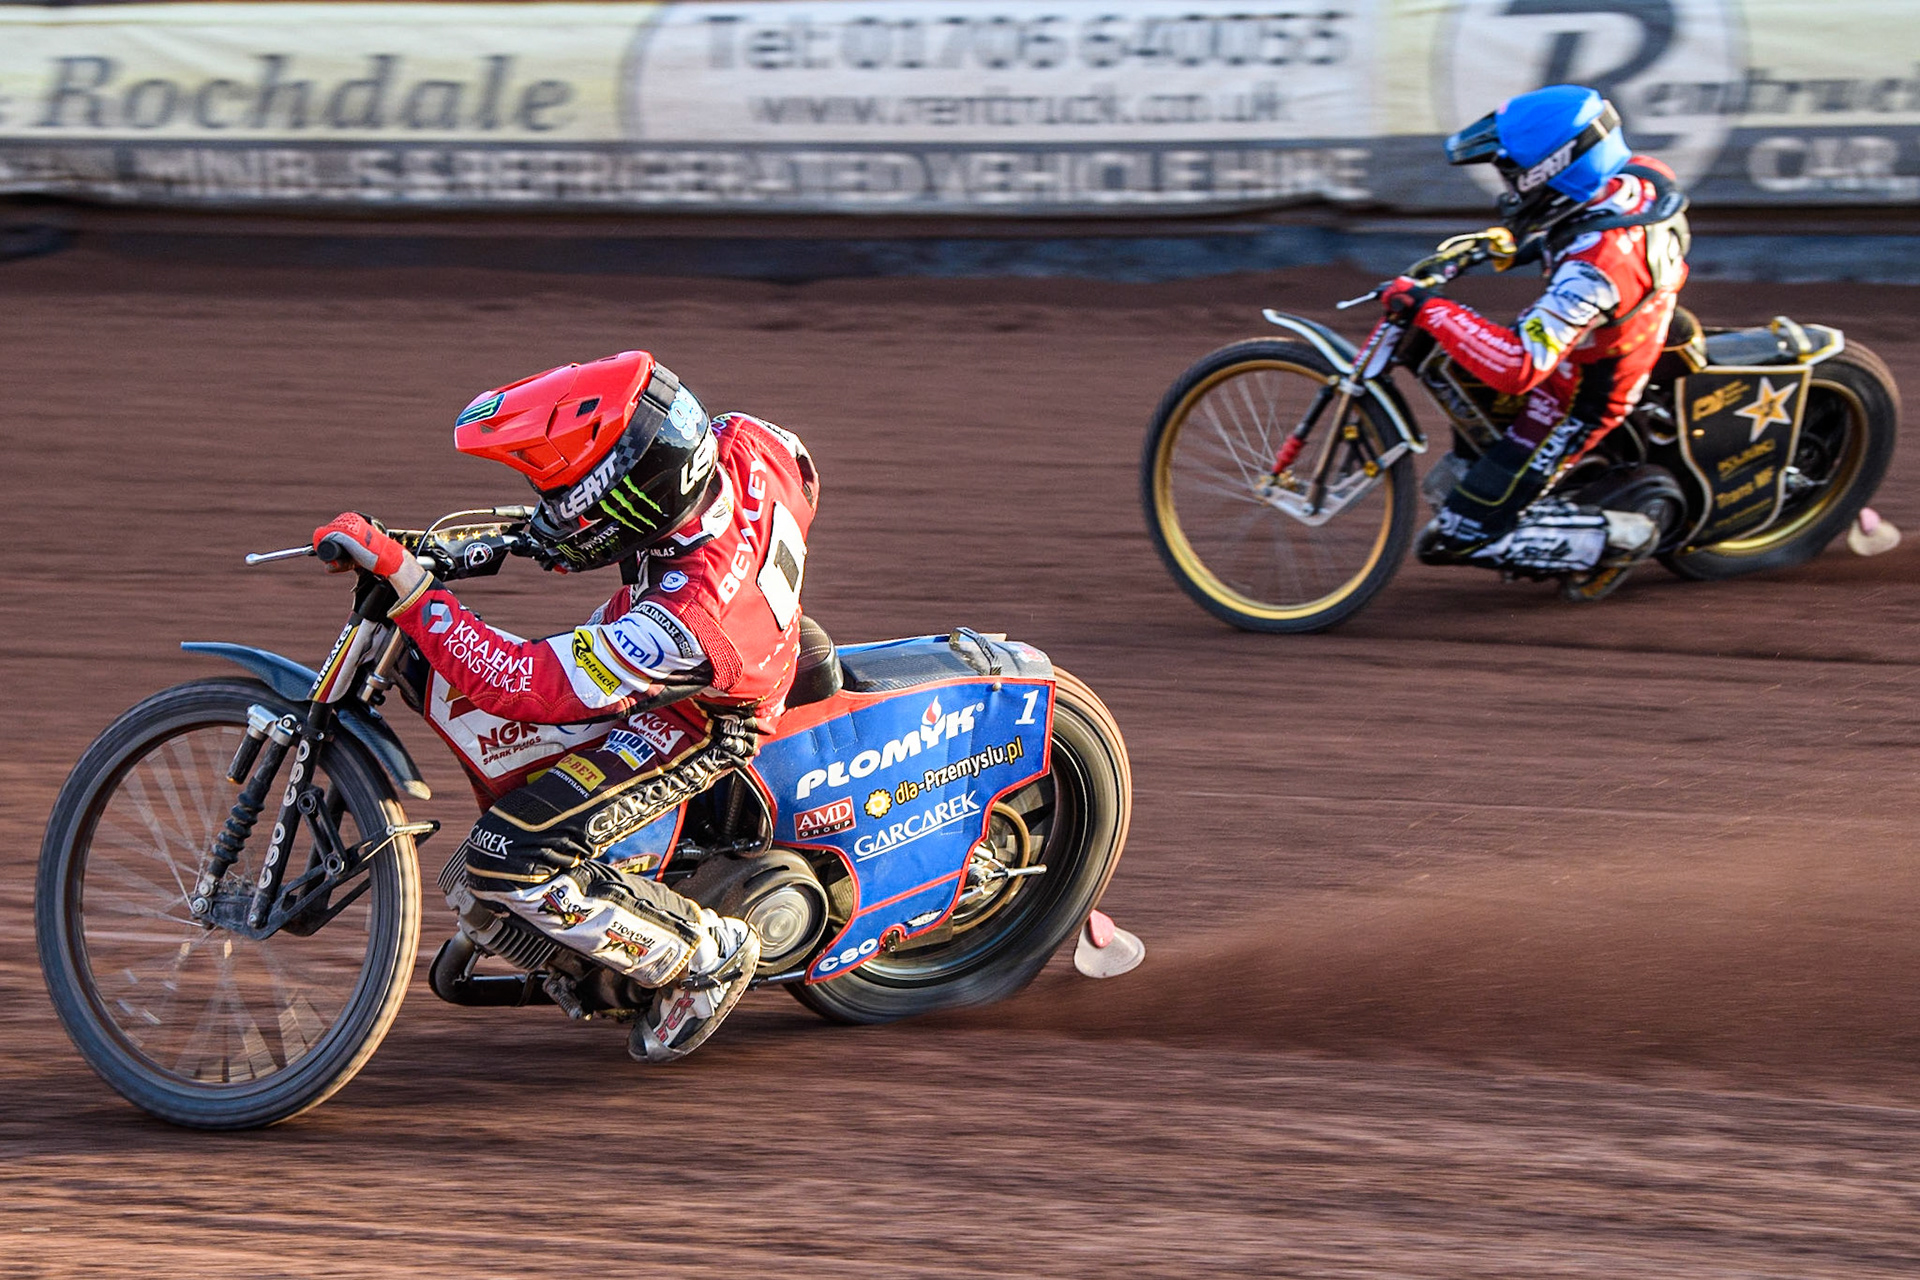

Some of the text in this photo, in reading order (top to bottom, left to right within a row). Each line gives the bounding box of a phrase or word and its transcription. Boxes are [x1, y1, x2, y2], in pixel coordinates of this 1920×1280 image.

[841, 15, 1068, 70] 01706
[32, 53, 578, 132] Rochdale
[559, 450, 618, 519] LEATT
[574, 631, 615, 690] Rentruck
[1014, 688, 1040, 726] 1
[477, 720, 539, 756] NGK
[632, 711, 678, 742] NGK
[645, 731, 667, 749] PLUGS
[483, 735, 542, 766] SPARK PLUGS
[796, 698, 977, 800] PŁOMYK
[797, 799, 852, 831] AMD
[801, 819, 851, 838] GROUP
[853, 789, 981, 858] GARCAREK
